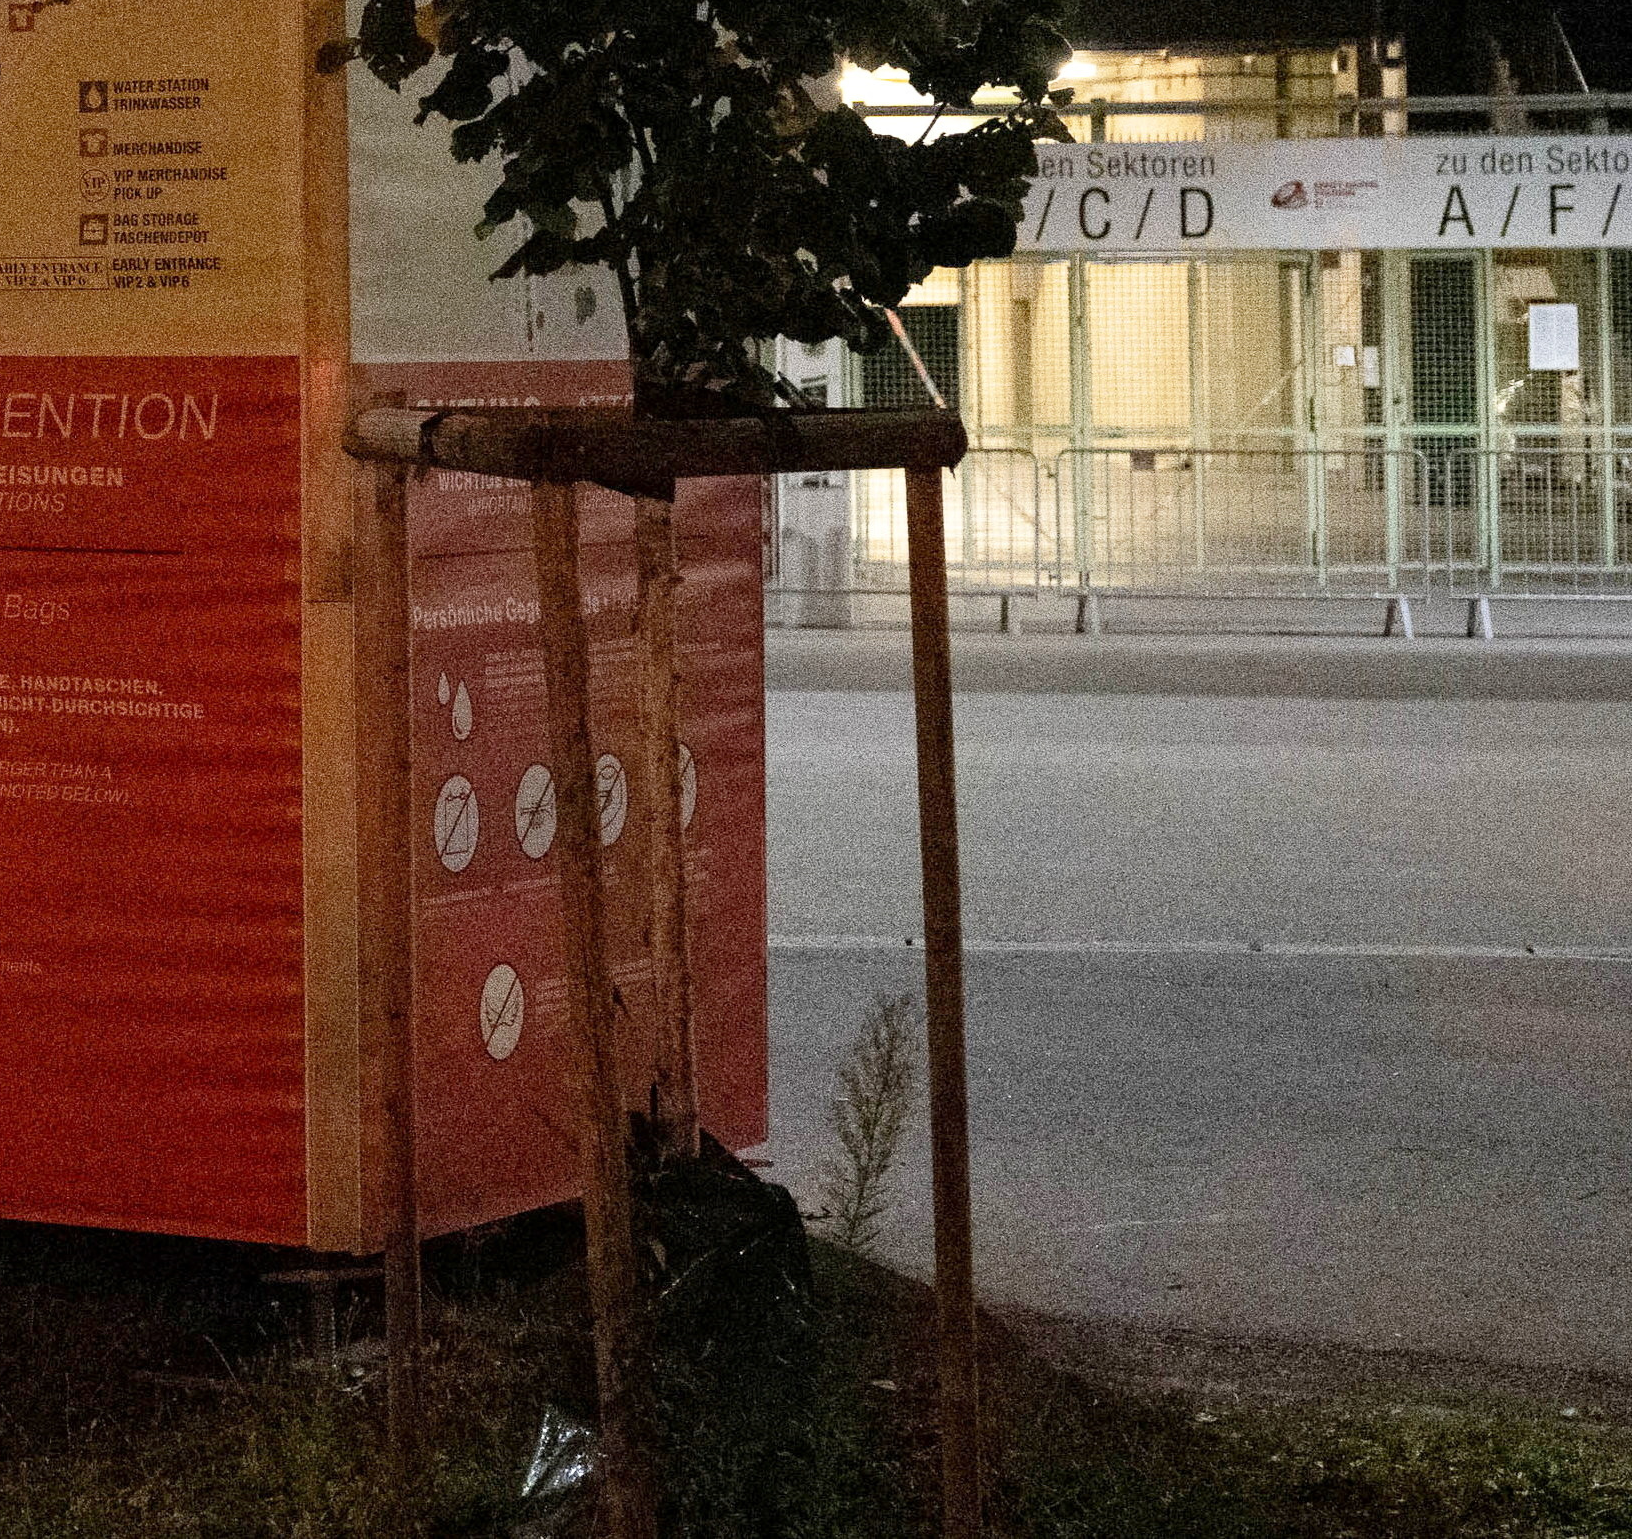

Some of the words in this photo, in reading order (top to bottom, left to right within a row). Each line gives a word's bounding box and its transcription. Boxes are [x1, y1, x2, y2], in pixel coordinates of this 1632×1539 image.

[113, 80, 153, 93] WATER
[157, 78, 209, 92] STATION
[113, 97, 201, 111] TRINKWASSER
[113, 141, 202, 156] MERCHANDISE
[1036, 151, 1074, 178] en
[1087, 149, 1216, 179] Sektoren
[1436, 152, 1467, 175] zu
[1480, 146, 1533, 175] den
[113, 169, 134, 183] VIP
[137, 167, 228, 181] MERCHANDISE
[113, 187, 142, 200] PICK
[146, 187, 163, 200] UP
[1078, 187, 1111, 240] C
[1180, 187, 1214, 238] D
[1437, 184, 1475, 236] A
[1549, 184, 1576, 235] F
[113, 213, 138, 227] BAG
[142, 212, 199, 227] STORAGE
[113, 230, 209, 244] TASCHENDEPOT
[113, 258, 149, 271] EARLY
[154, 257, 222, 271] ENTRANCE
[4, 593, 70, 625] Bags
